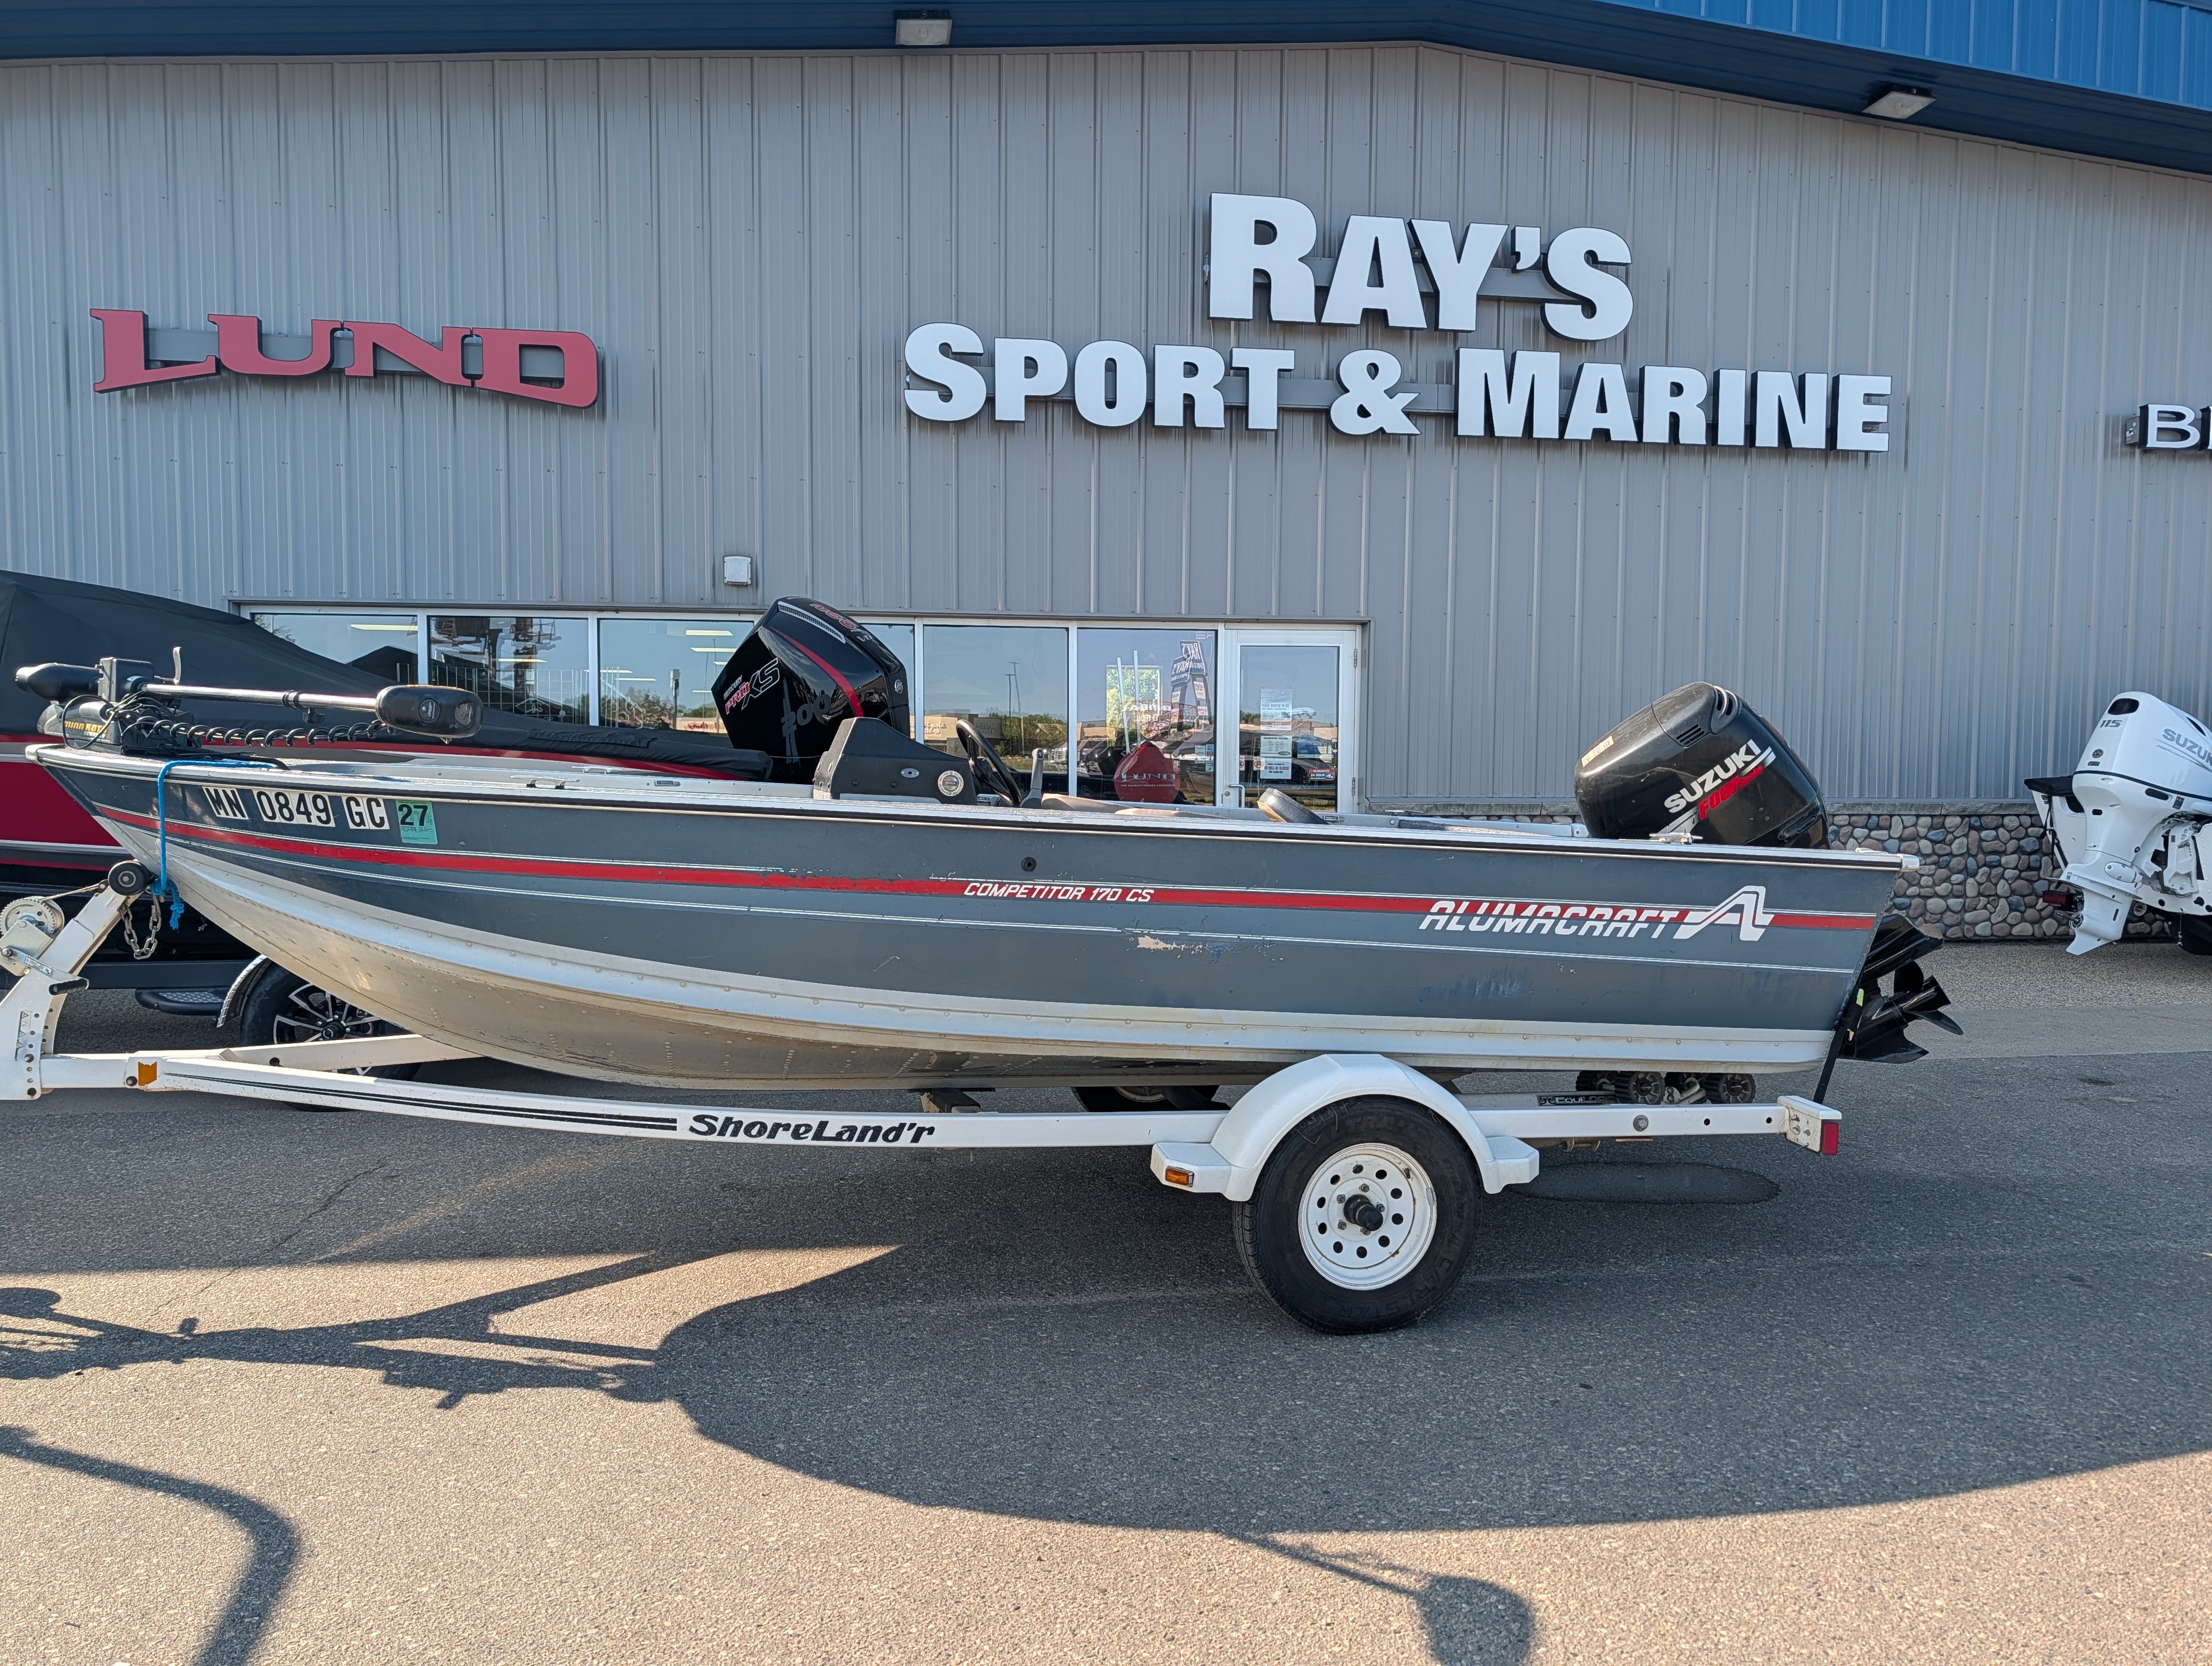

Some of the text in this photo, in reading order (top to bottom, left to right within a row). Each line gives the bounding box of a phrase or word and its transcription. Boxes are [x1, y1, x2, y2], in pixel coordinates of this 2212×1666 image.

[1207, 192, 1634, 342] RAY'S
[90, 309, 597, 408] LUND
[904, 322, 1893, 453] SPORT & MARINE
[2145, 403, 2212, 450] B
[2100, 719, 2123, 728] 115
[1121, 773, 1176, 783] LUND
[1664, 739, 1761, 813] SUZUKI
[205, 788, 385, 828] MN 0849 GC
[398, 804, 428, 826] 27
[964, 882, 1155, 902] COMPETITOR 170 CS
[1419, 901, 1680, 940] ALUMACRAFT
[689, 1114, 935, 1144] ShoreLand'r
